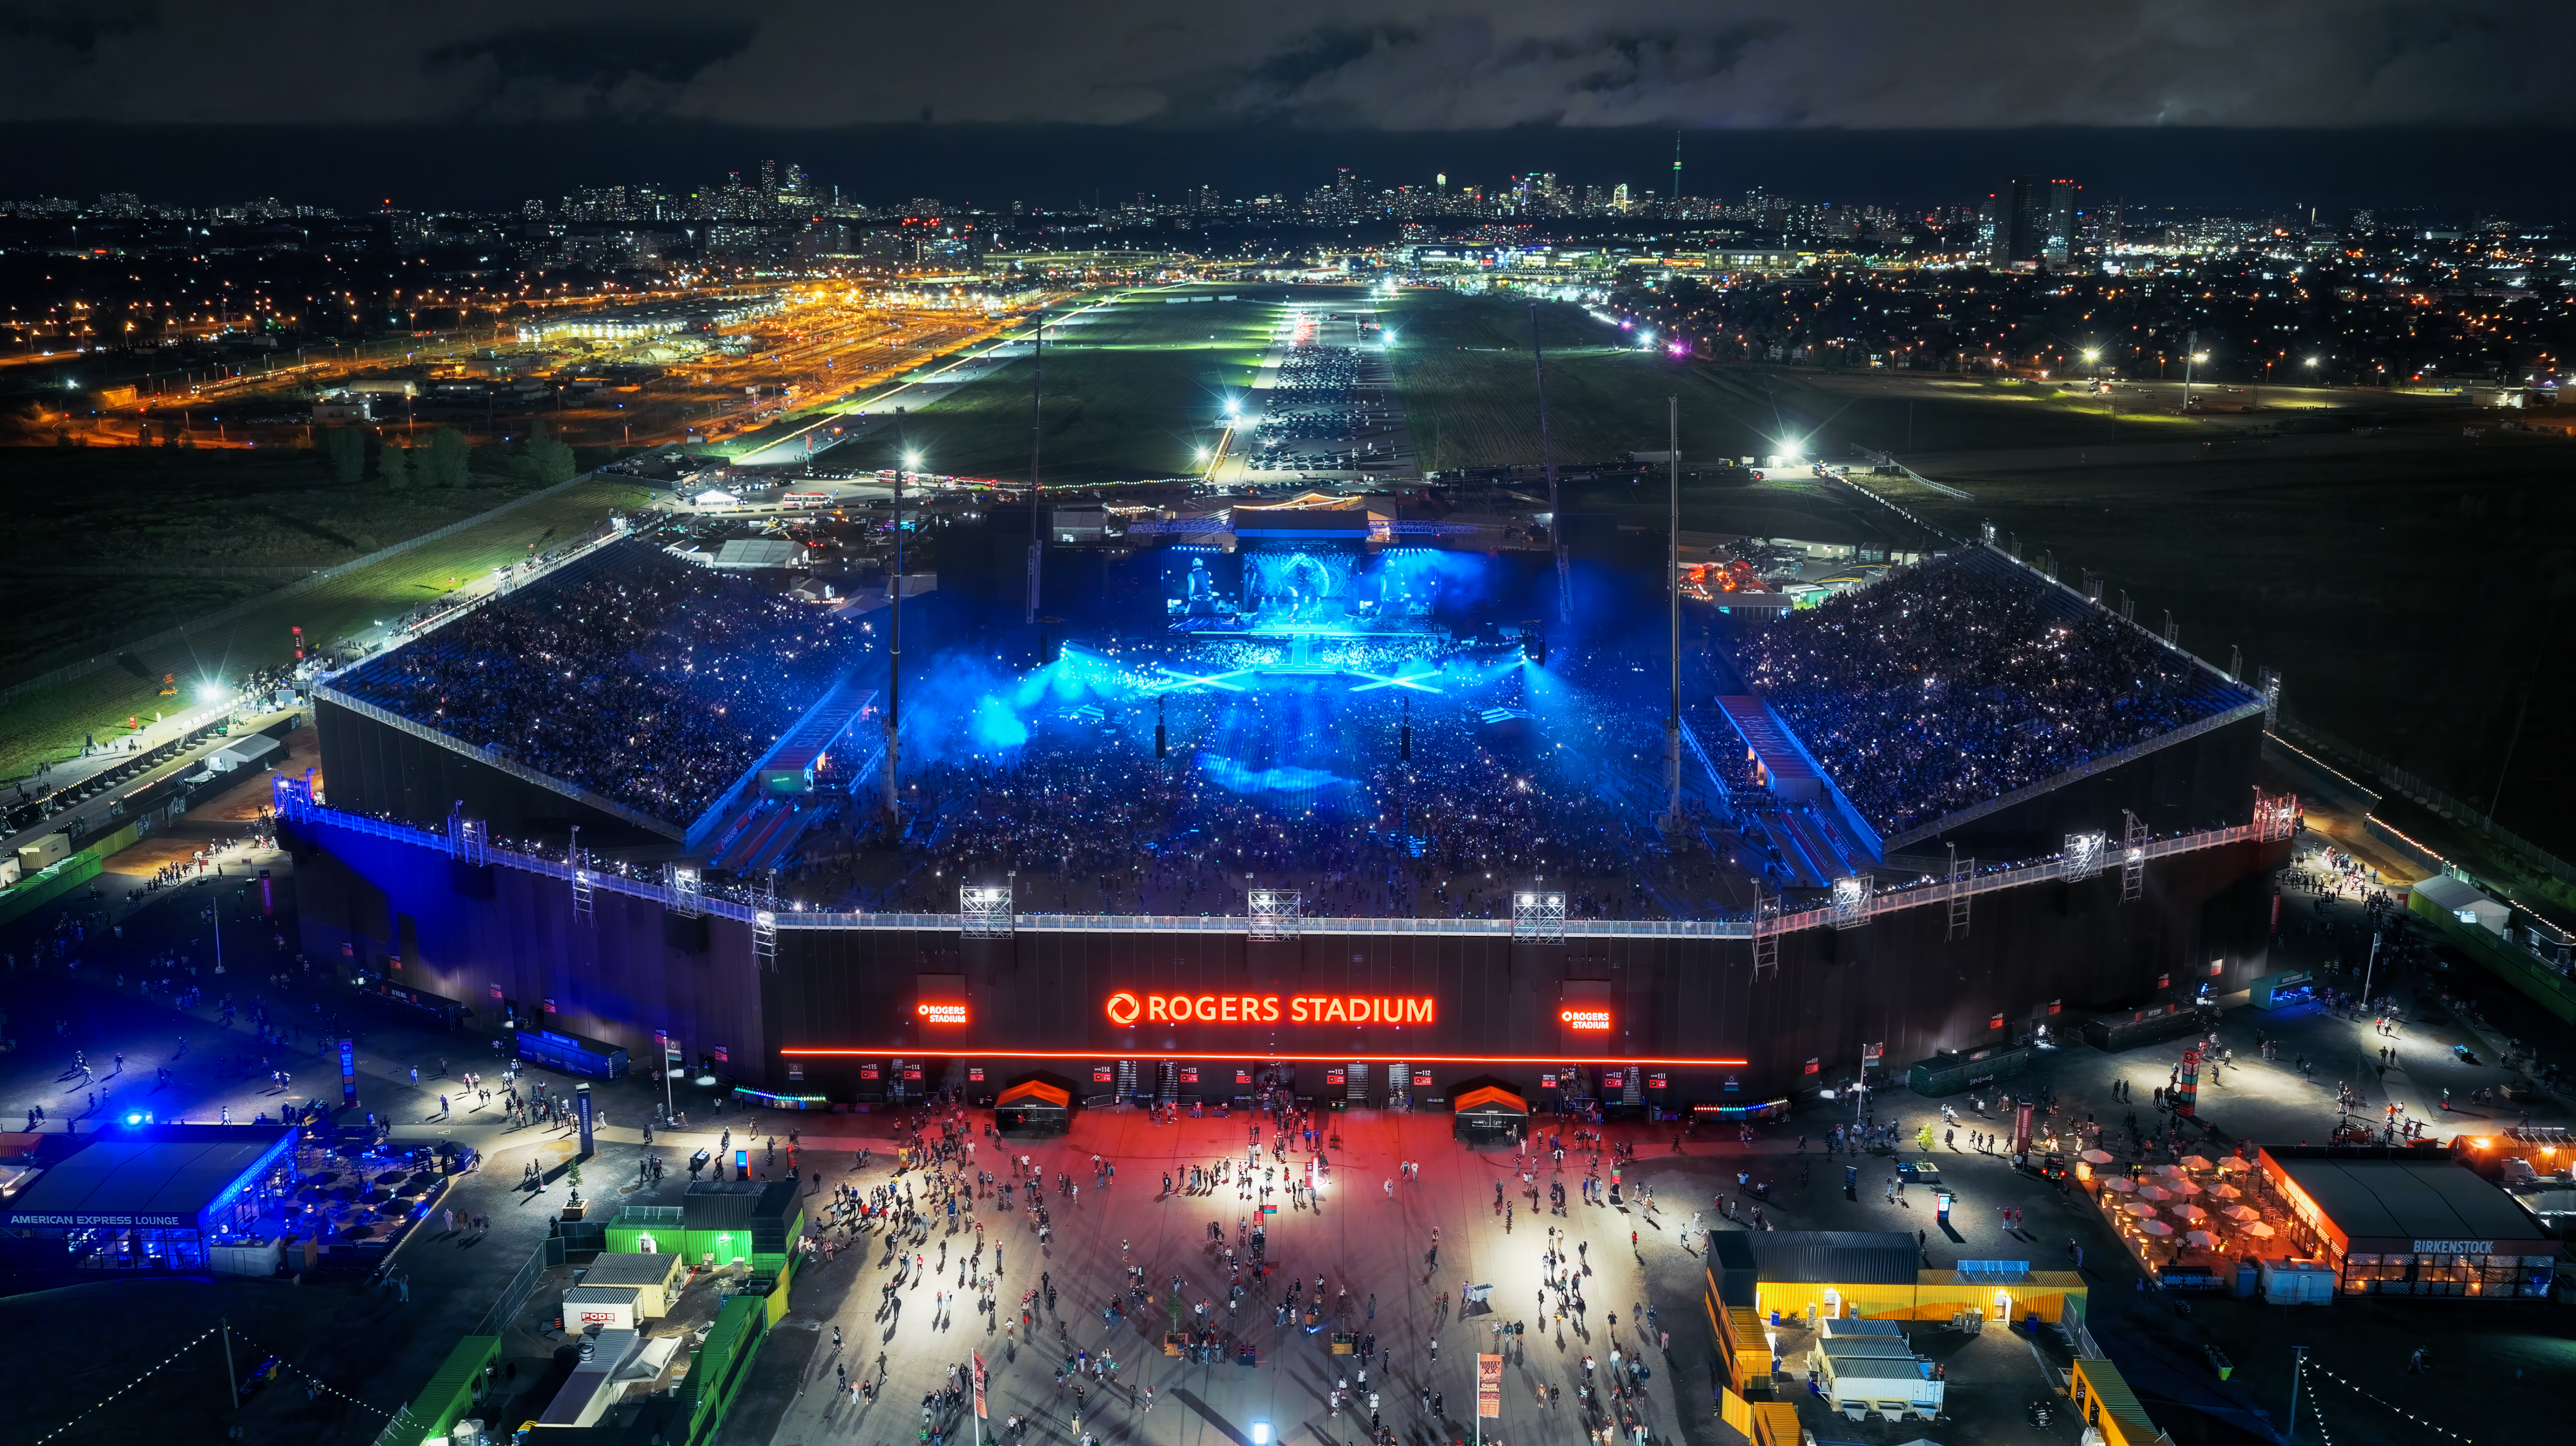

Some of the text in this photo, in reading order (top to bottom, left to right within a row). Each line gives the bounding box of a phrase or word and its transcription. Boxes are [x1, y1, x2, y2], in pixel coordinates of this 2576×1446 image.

[929, 1006, 965, 1014] ROGERS
[1149, 996, 1432, 1022] ROGERS STADIUM
[929, 1014, 966, 1023] STADIUM
[1573, 1012, 1609, 1021] ROGERS
[1572, 1021, 1609, 1029] STADIUM
[268, 1139, 288, 1163] LOUNGE
[10, 1215, 179, 1225] AMERICAN EXPRESS LOUNGE
[2413, 1240, 2493, 1253] BIRKENSTOCK
